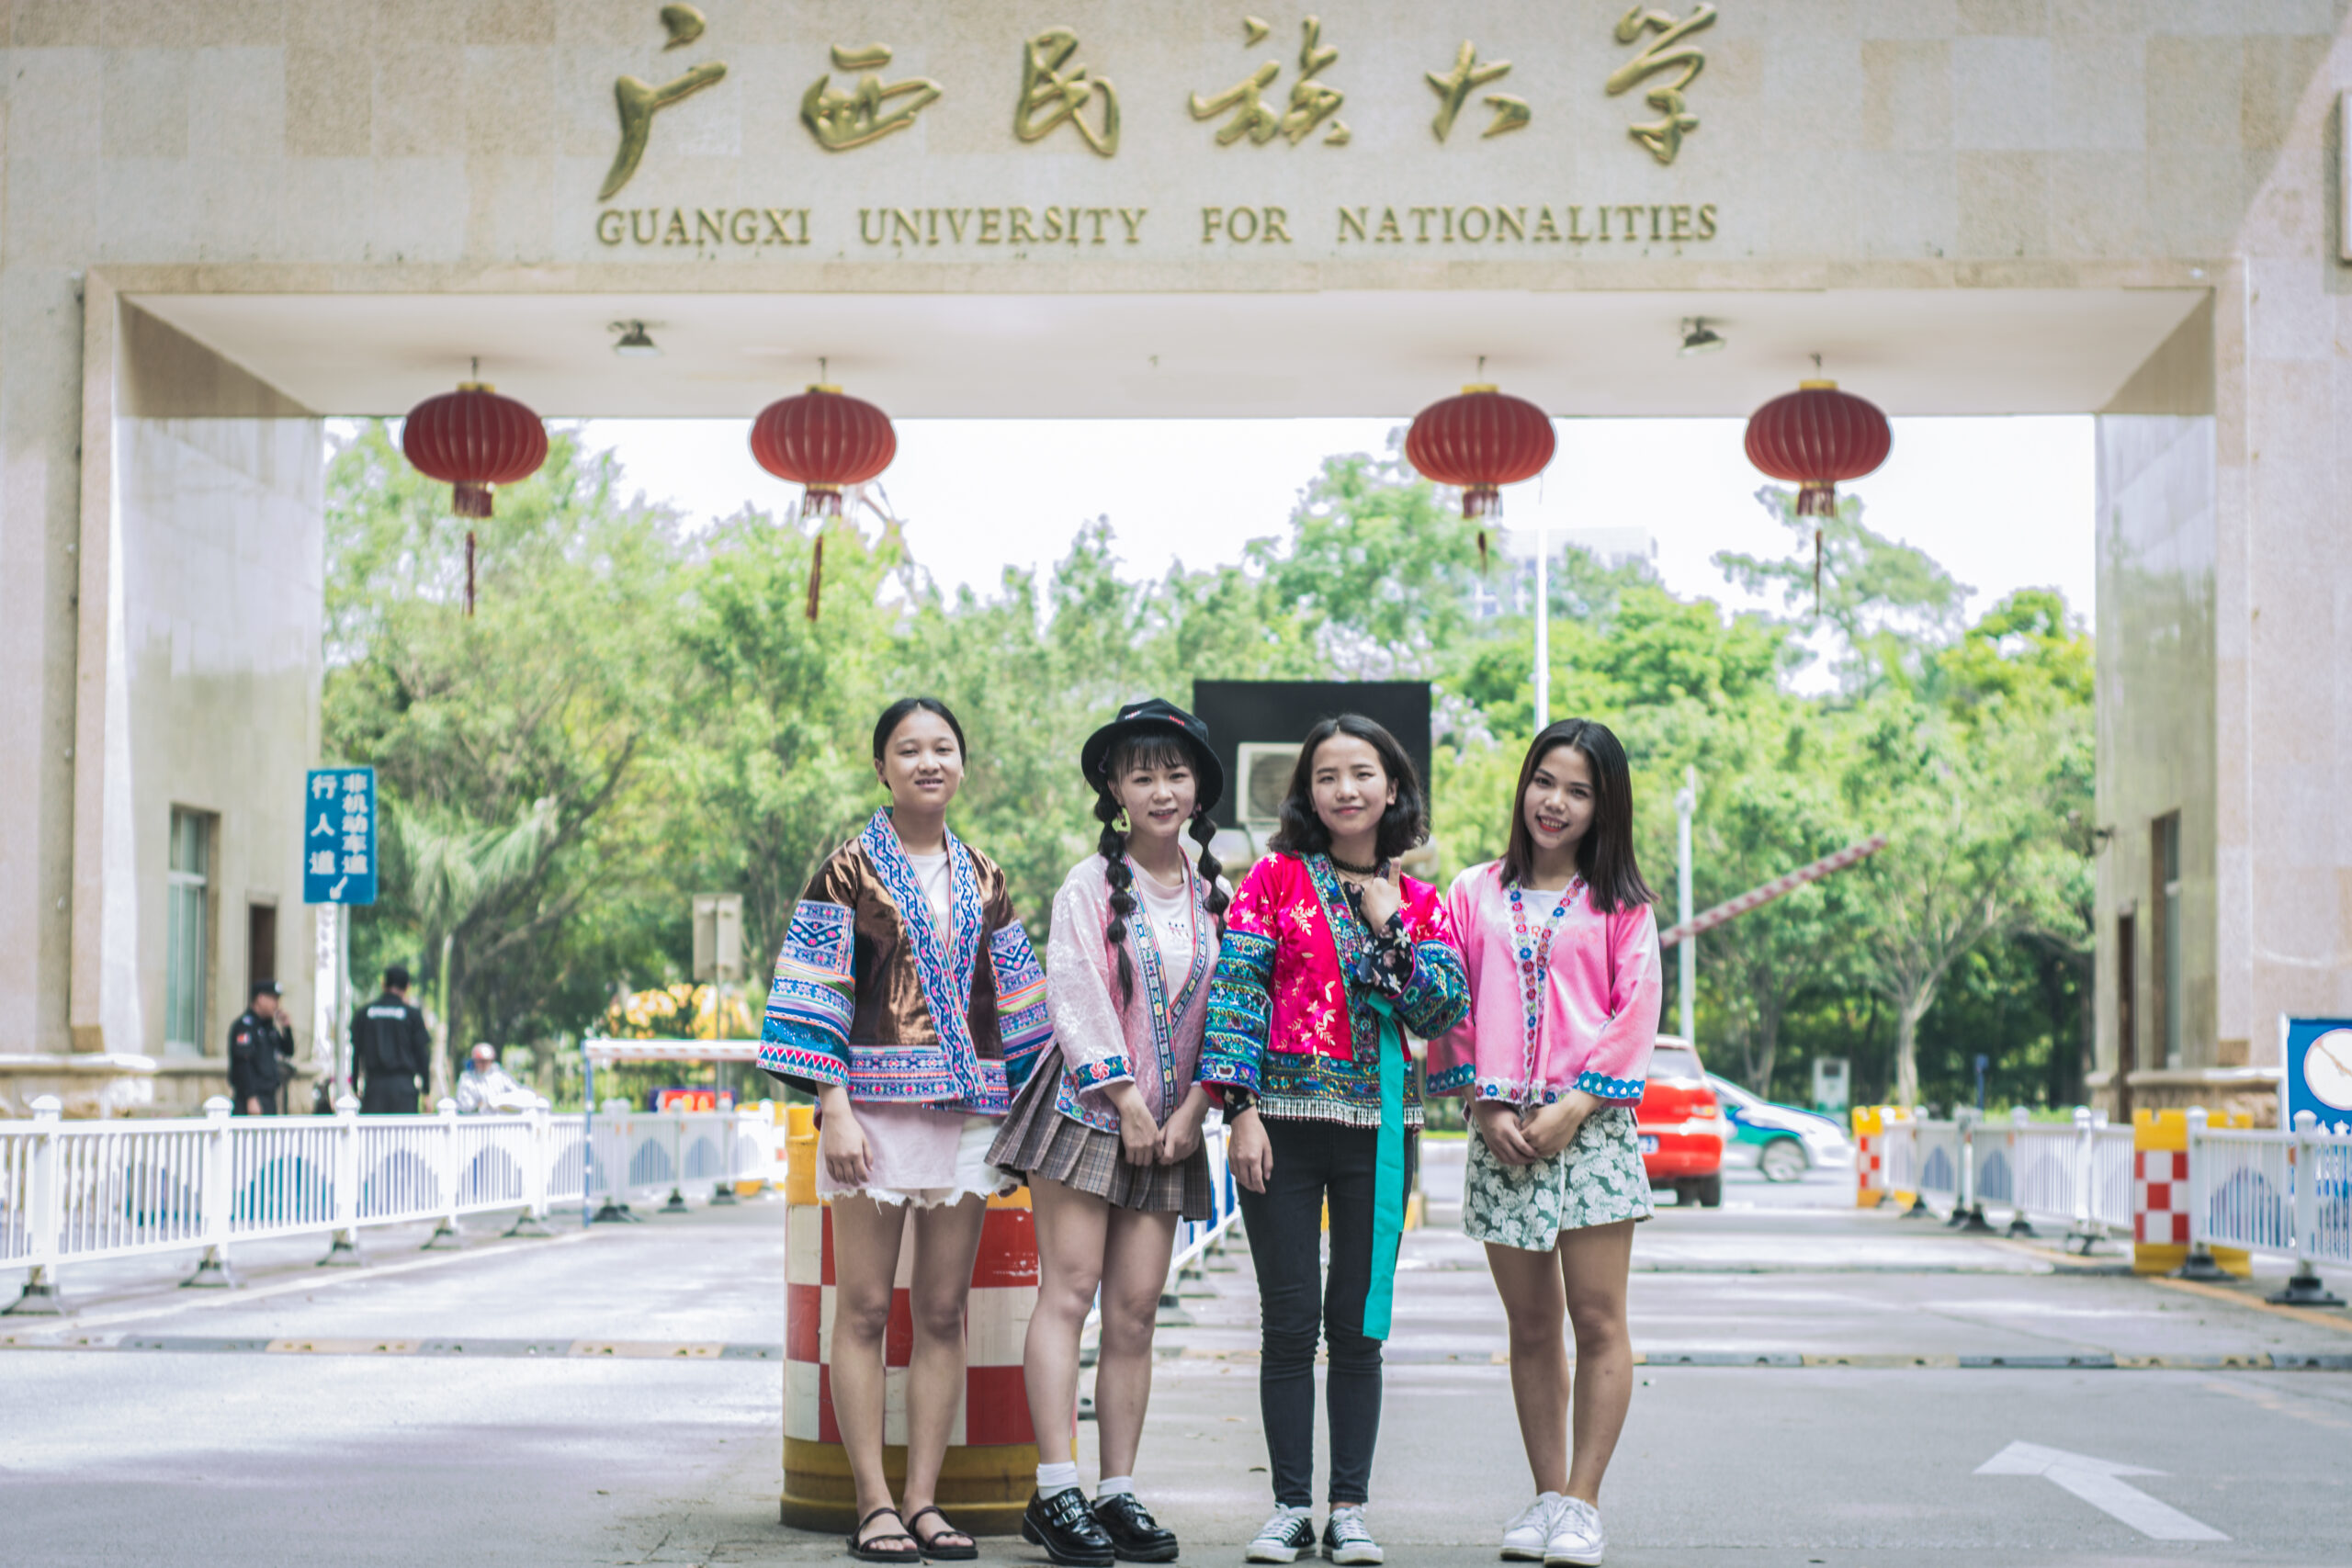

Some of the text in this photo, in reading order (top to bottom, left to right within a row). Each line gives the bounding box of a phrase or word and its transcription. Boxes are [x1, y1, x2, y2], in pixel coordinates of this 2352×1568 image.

[599, 3, 1715, 200] 广西民族大学
[597, 203, 1717, 246] GUANGXI UNIVERSITY FOR NATIONALITIES
[309, 774, 337, 874] 行人道
[342, 773, 368, 874] 非机动车道
